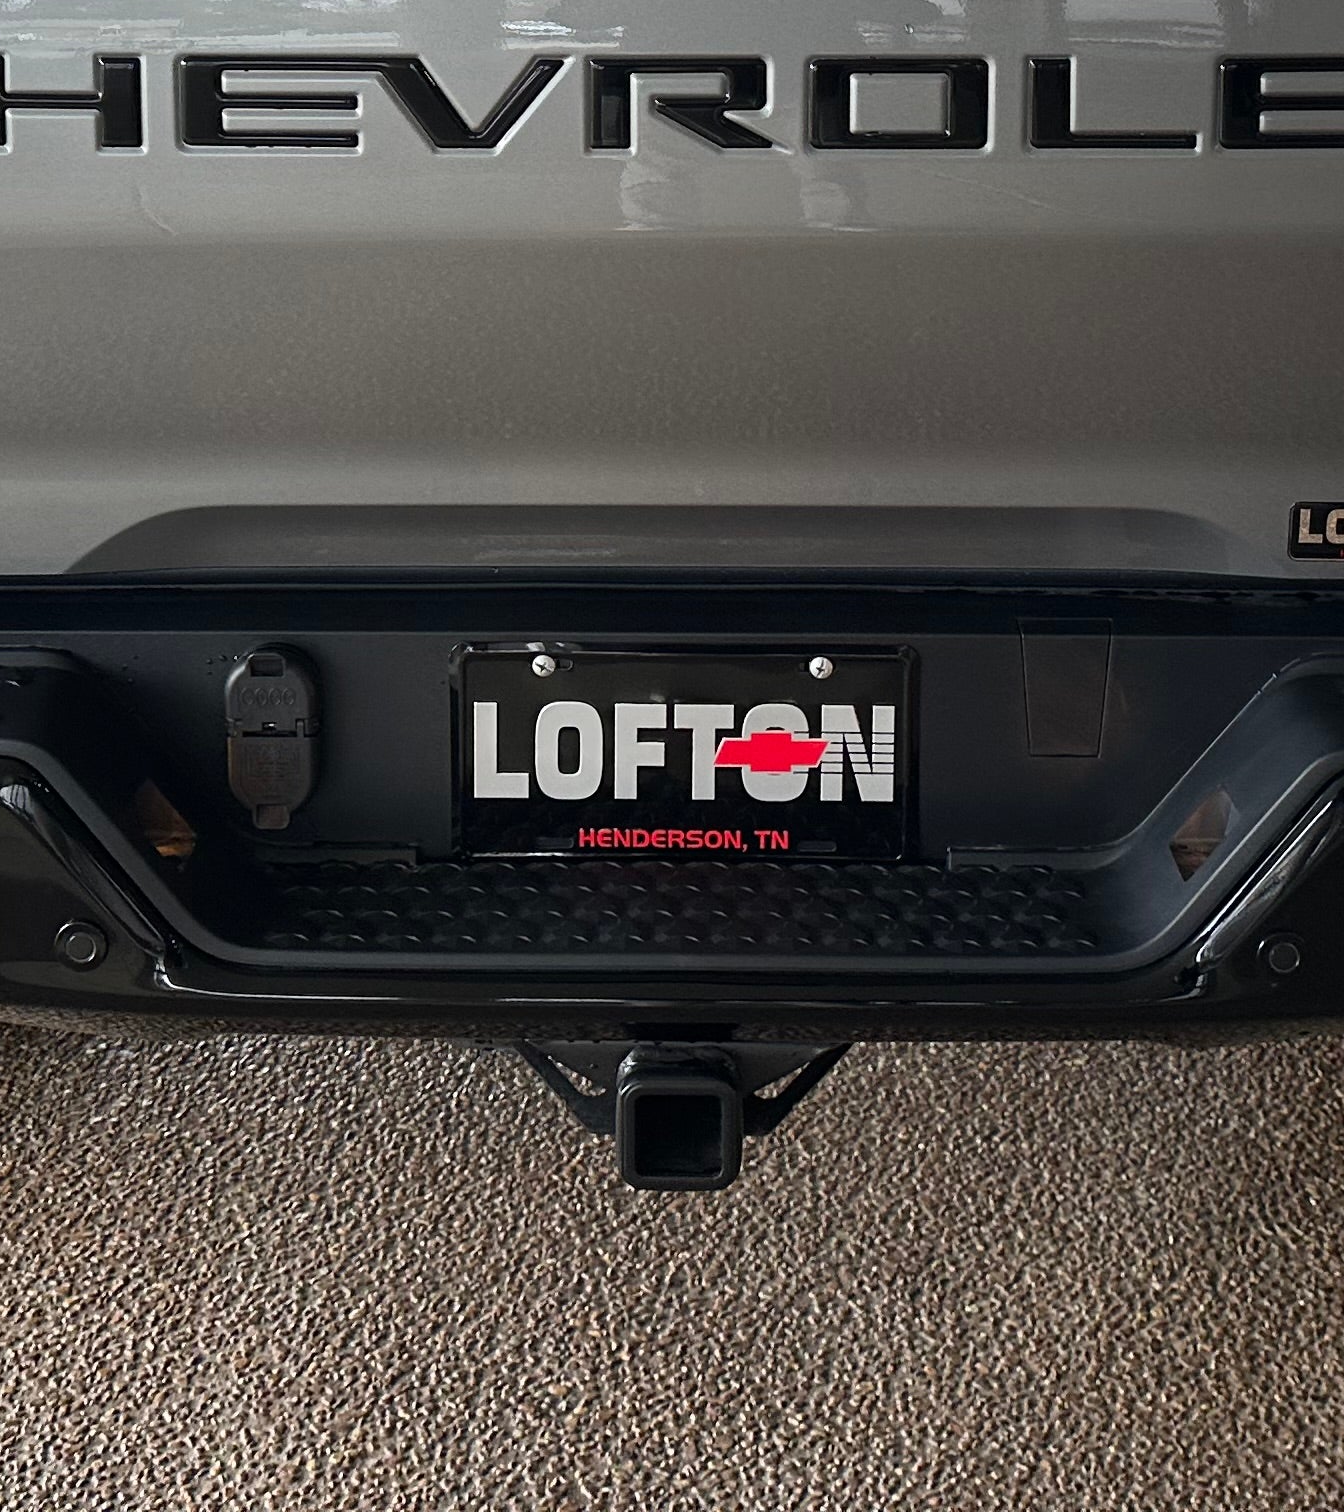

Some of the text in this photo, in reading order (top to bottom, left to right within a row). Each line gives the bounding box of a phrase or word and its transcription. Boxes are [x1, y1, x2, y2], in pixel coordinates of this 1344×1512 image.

[473, 701, 896, 802] LOFTON
[578, 828, 789, 852] HENDERSON, TN
